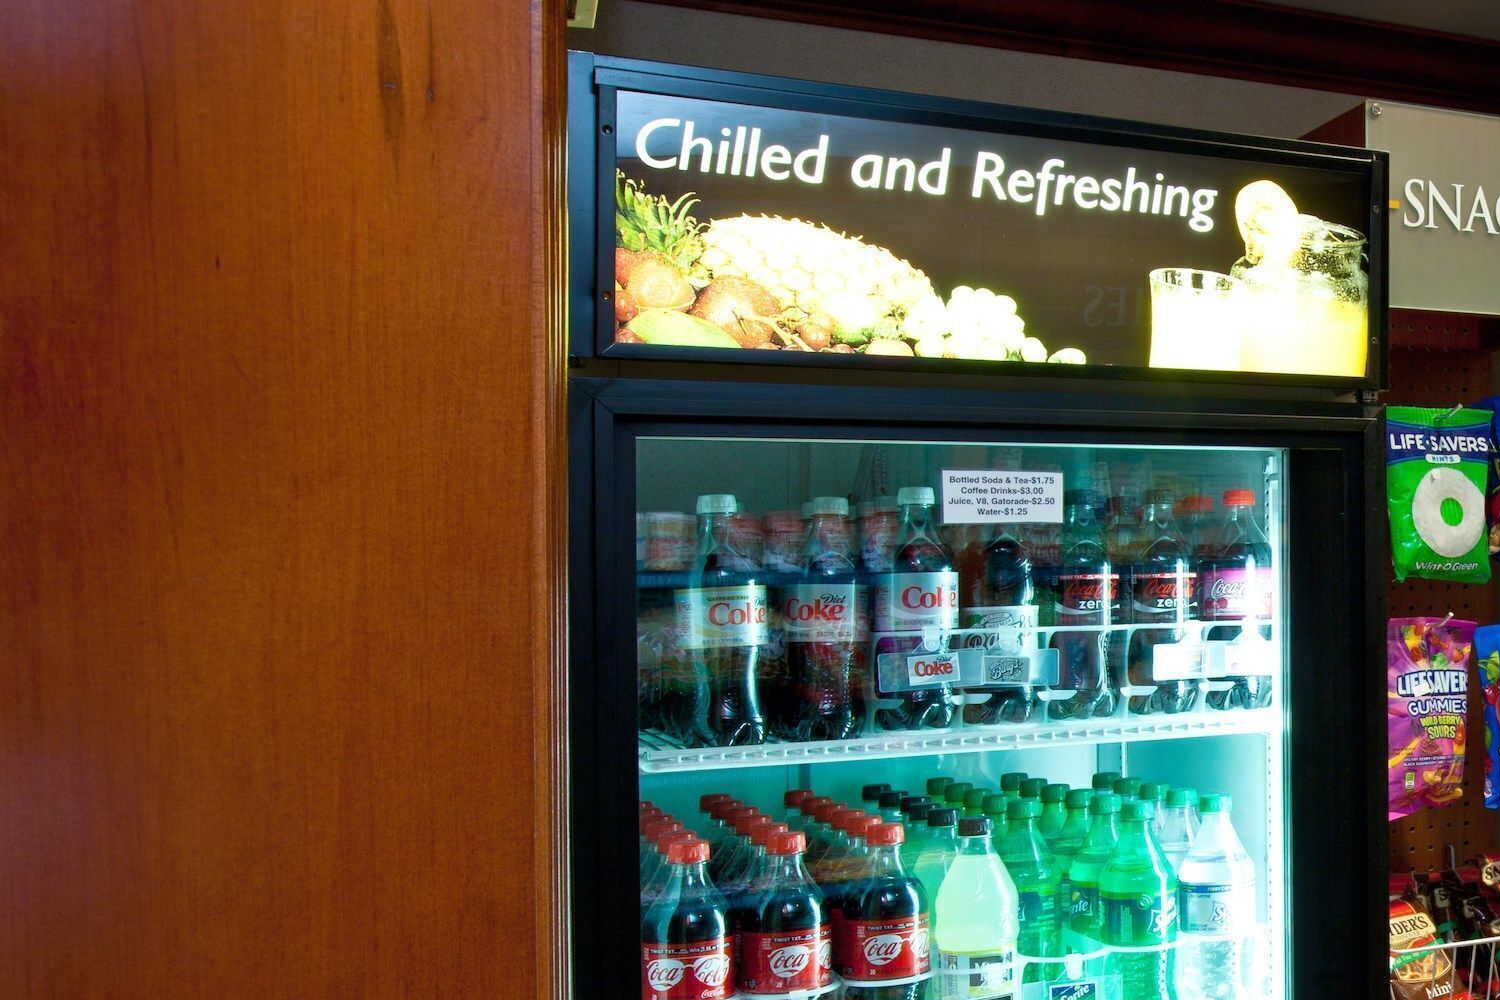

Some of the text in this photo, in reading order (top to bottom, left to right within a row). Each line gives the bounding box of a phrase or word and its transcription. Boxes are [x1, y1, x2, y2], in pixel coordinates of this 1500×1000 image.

[635, 118, 1218, 233] Chilled and Refreshing
[949, 476, 1055, 485] Bottled Soda & Tea-$1.75
[961, 487, 1044, 495] Coffee Drinks-$3.00
[949, 498, 974, 506] Juice,
[991, 498, 1055, 506] Gatorade-$2.50
[977, 508, 1028, 516] Water-$1.25
[820, 593, 846, 604] Diet
[785, 598, 845, 621] Coke
[914, 661, 954, 677] Coke
[1408, 699, 1467, 715] GUMMIES
[1427, 725, 1456, 739] SOURS
[864, 938, 898, 957] Coca
[769, 949, 806, 969] Coca
[648, 961, 683, 981] Coca
[1426, 981, 1452, 1000] Mini
